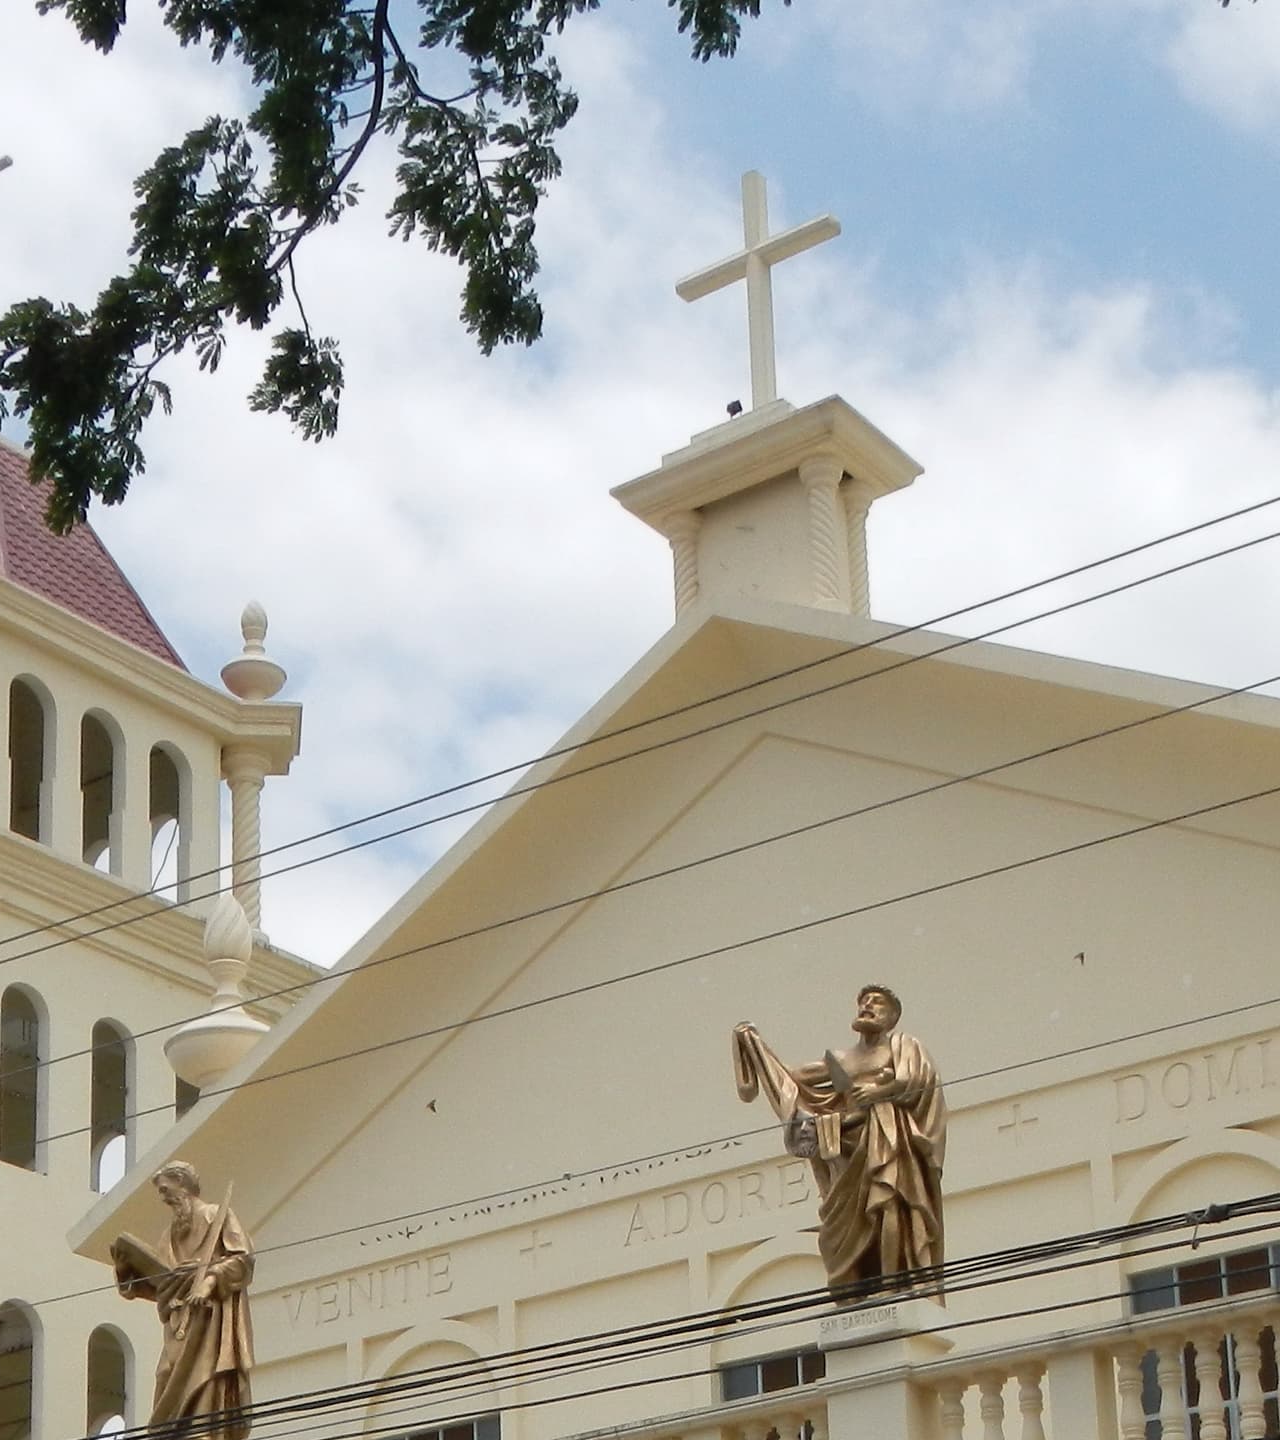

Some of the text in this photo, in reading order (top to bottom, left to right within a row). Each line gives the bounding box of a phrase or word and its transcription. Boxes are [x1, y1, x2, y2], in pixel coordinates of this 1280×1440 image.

[283, 1252, 455, 1327] VENITE
[624, 1159, 813, 1247] ADORE
[841, 1306, 898, 1330] BARTOLOME
